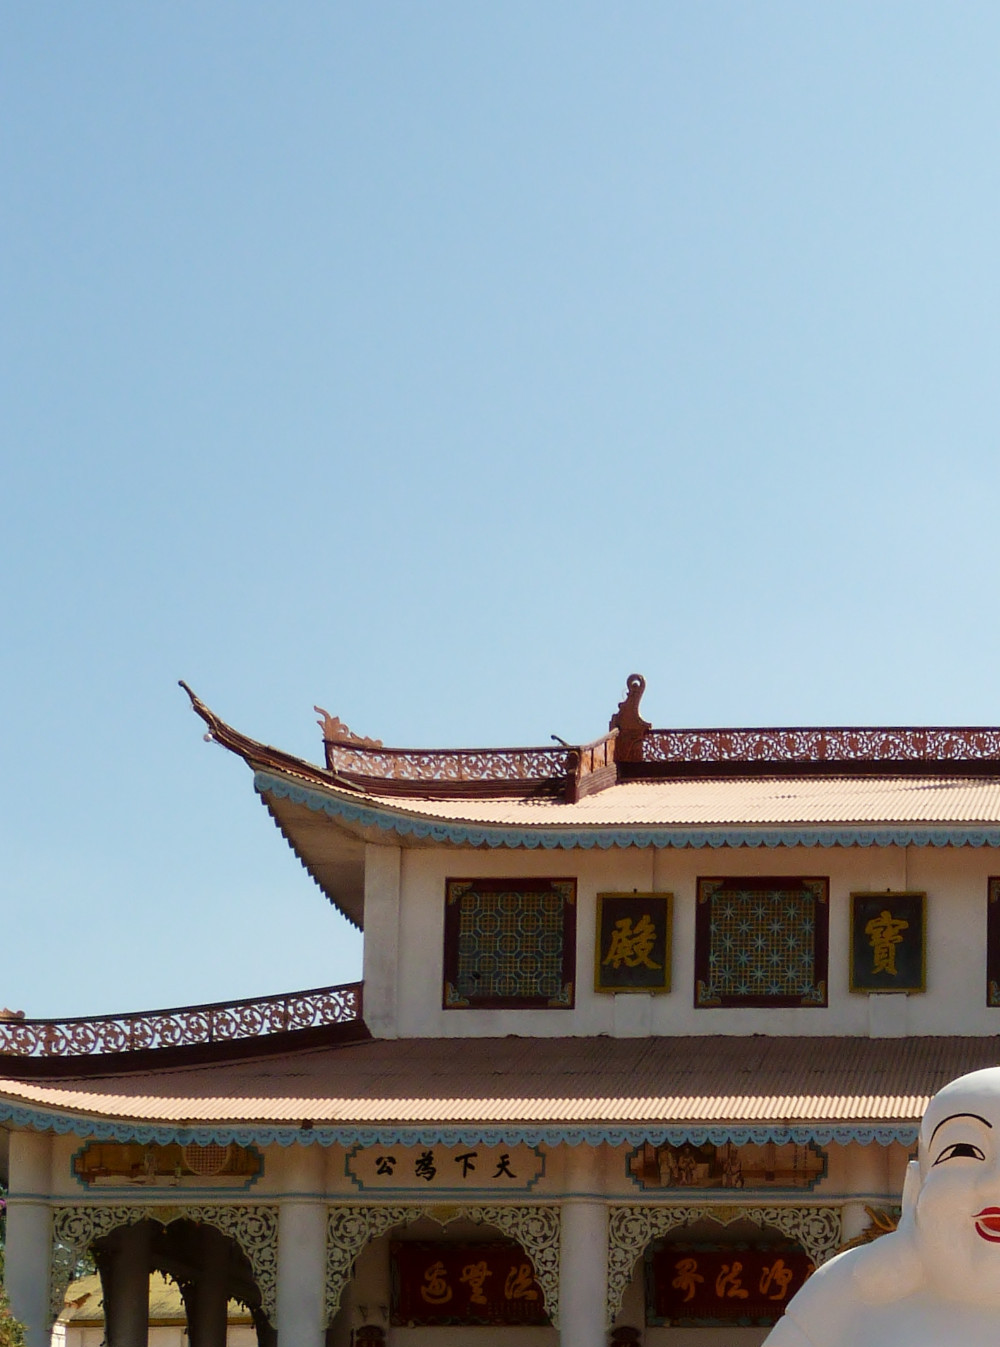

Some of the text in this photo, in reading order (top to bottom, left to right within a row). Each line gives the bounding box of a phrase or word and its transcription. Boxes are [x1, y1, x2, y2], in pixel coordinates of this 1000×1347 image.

[602, 915, 664, 973] 殿
[864, 910, 910, 976] 寶
[374, 1149, 518, 1182] 天下為公
[671, 1257, 818, 1303] 淨法界
